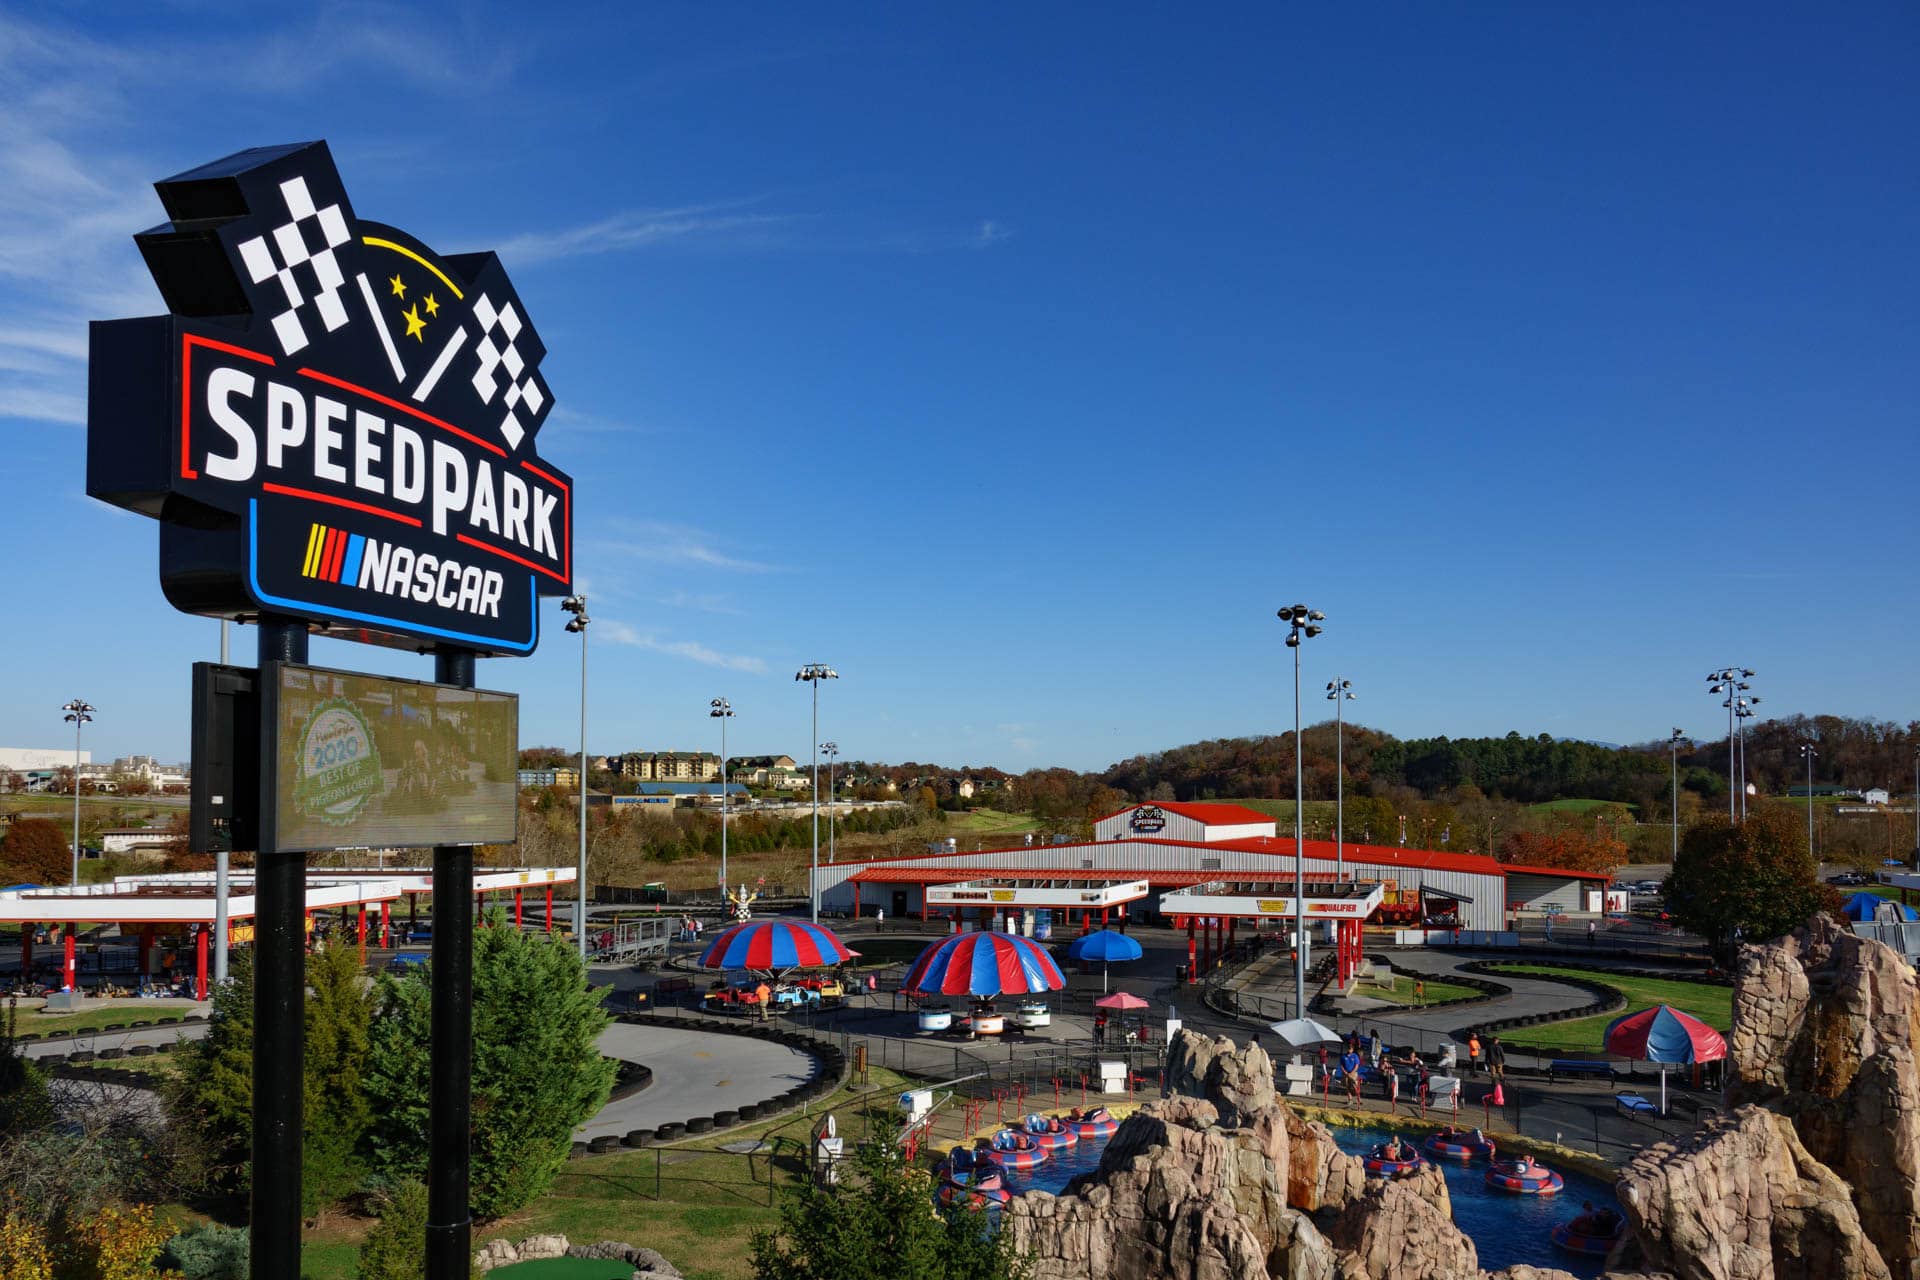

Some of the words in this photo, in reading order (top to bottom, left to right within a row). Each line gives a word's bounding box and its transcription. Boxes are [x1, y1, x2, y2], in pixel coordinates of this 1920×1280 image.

[357, 538, 504, 619] NASCAR
[313, 736, 358, 769] 2020
[319, 767, 345, 788] BEST
[347, 762, 361, 777] OF
[952, 891, 988, 899] Bristol
[1321, 903, 1357, 912] QUALIFIER
